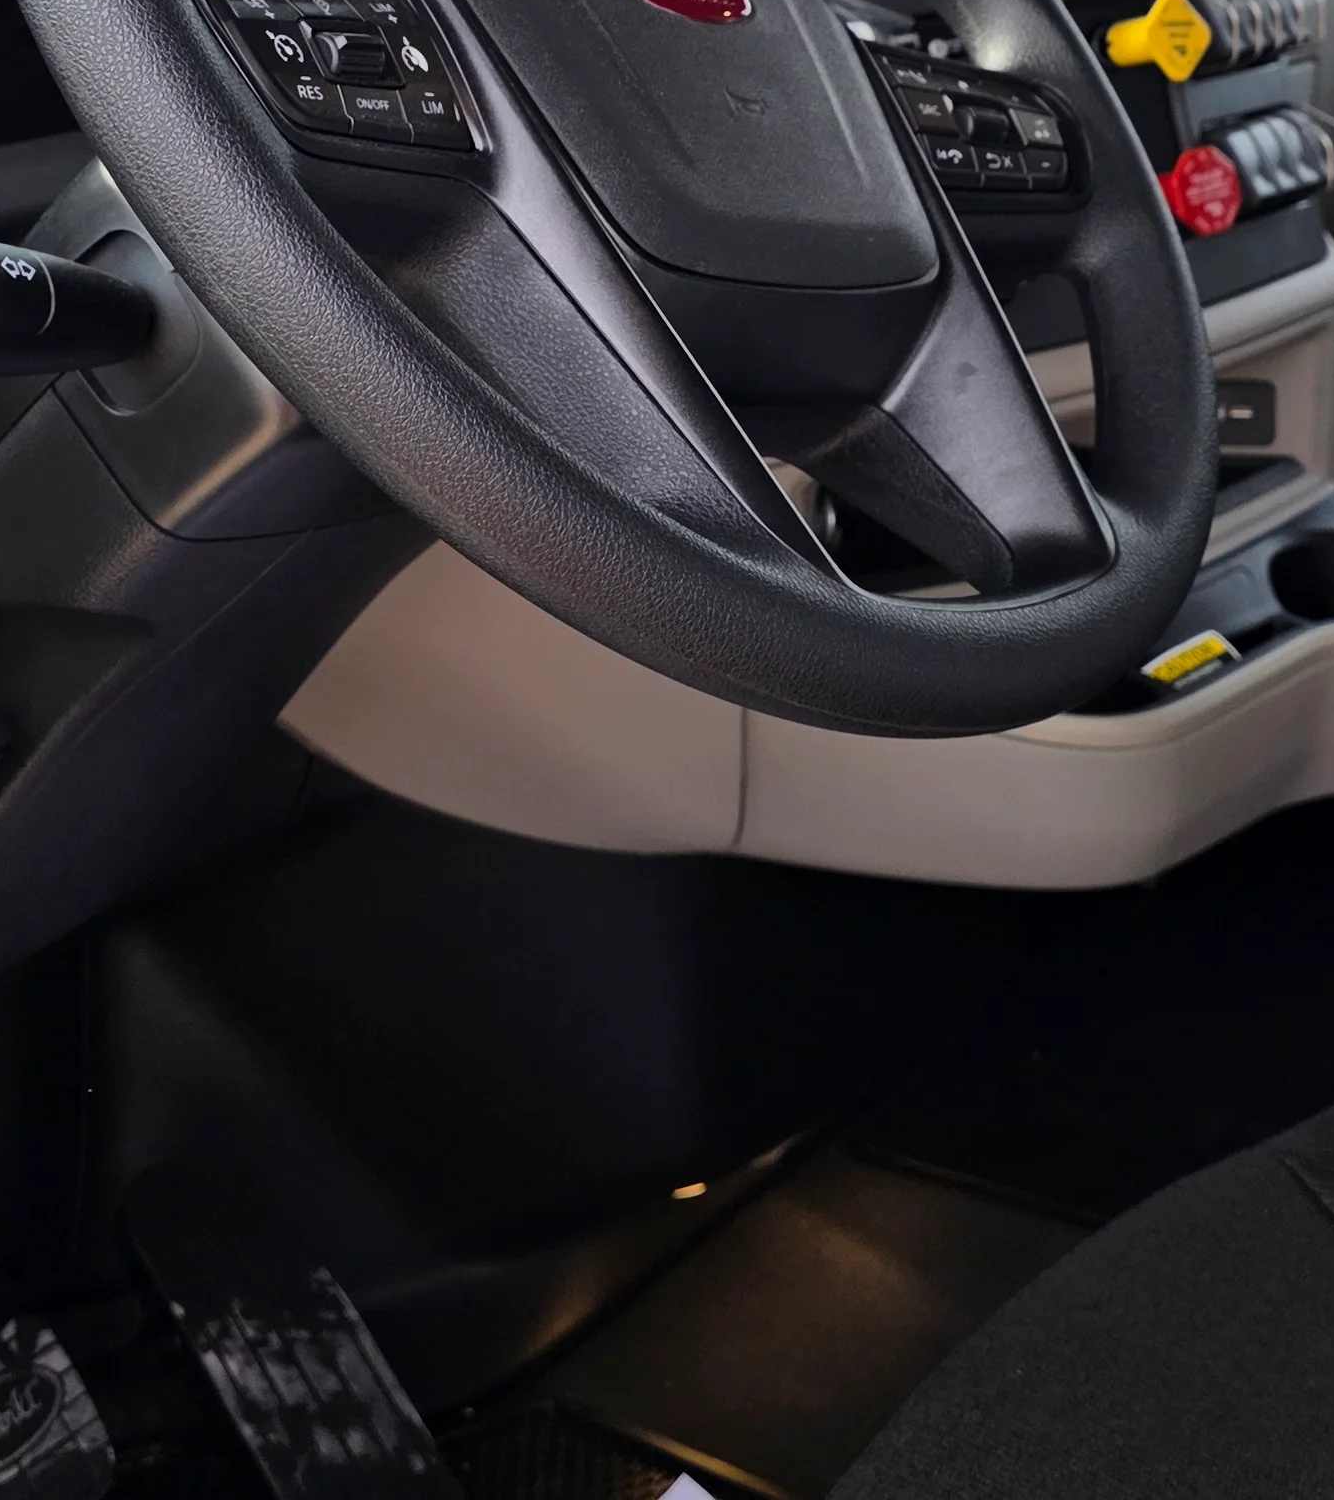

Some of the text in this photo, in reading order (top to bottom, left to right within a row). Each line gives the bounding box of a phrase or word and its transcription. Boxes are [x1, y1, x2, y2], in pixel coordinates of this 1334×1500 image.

[369, 3, 396, 13] LIM
[296, 85, 325, 100] RES
[356, 98, 391, 112] ON/OFF
[421, 100, 445, 115] LIM
